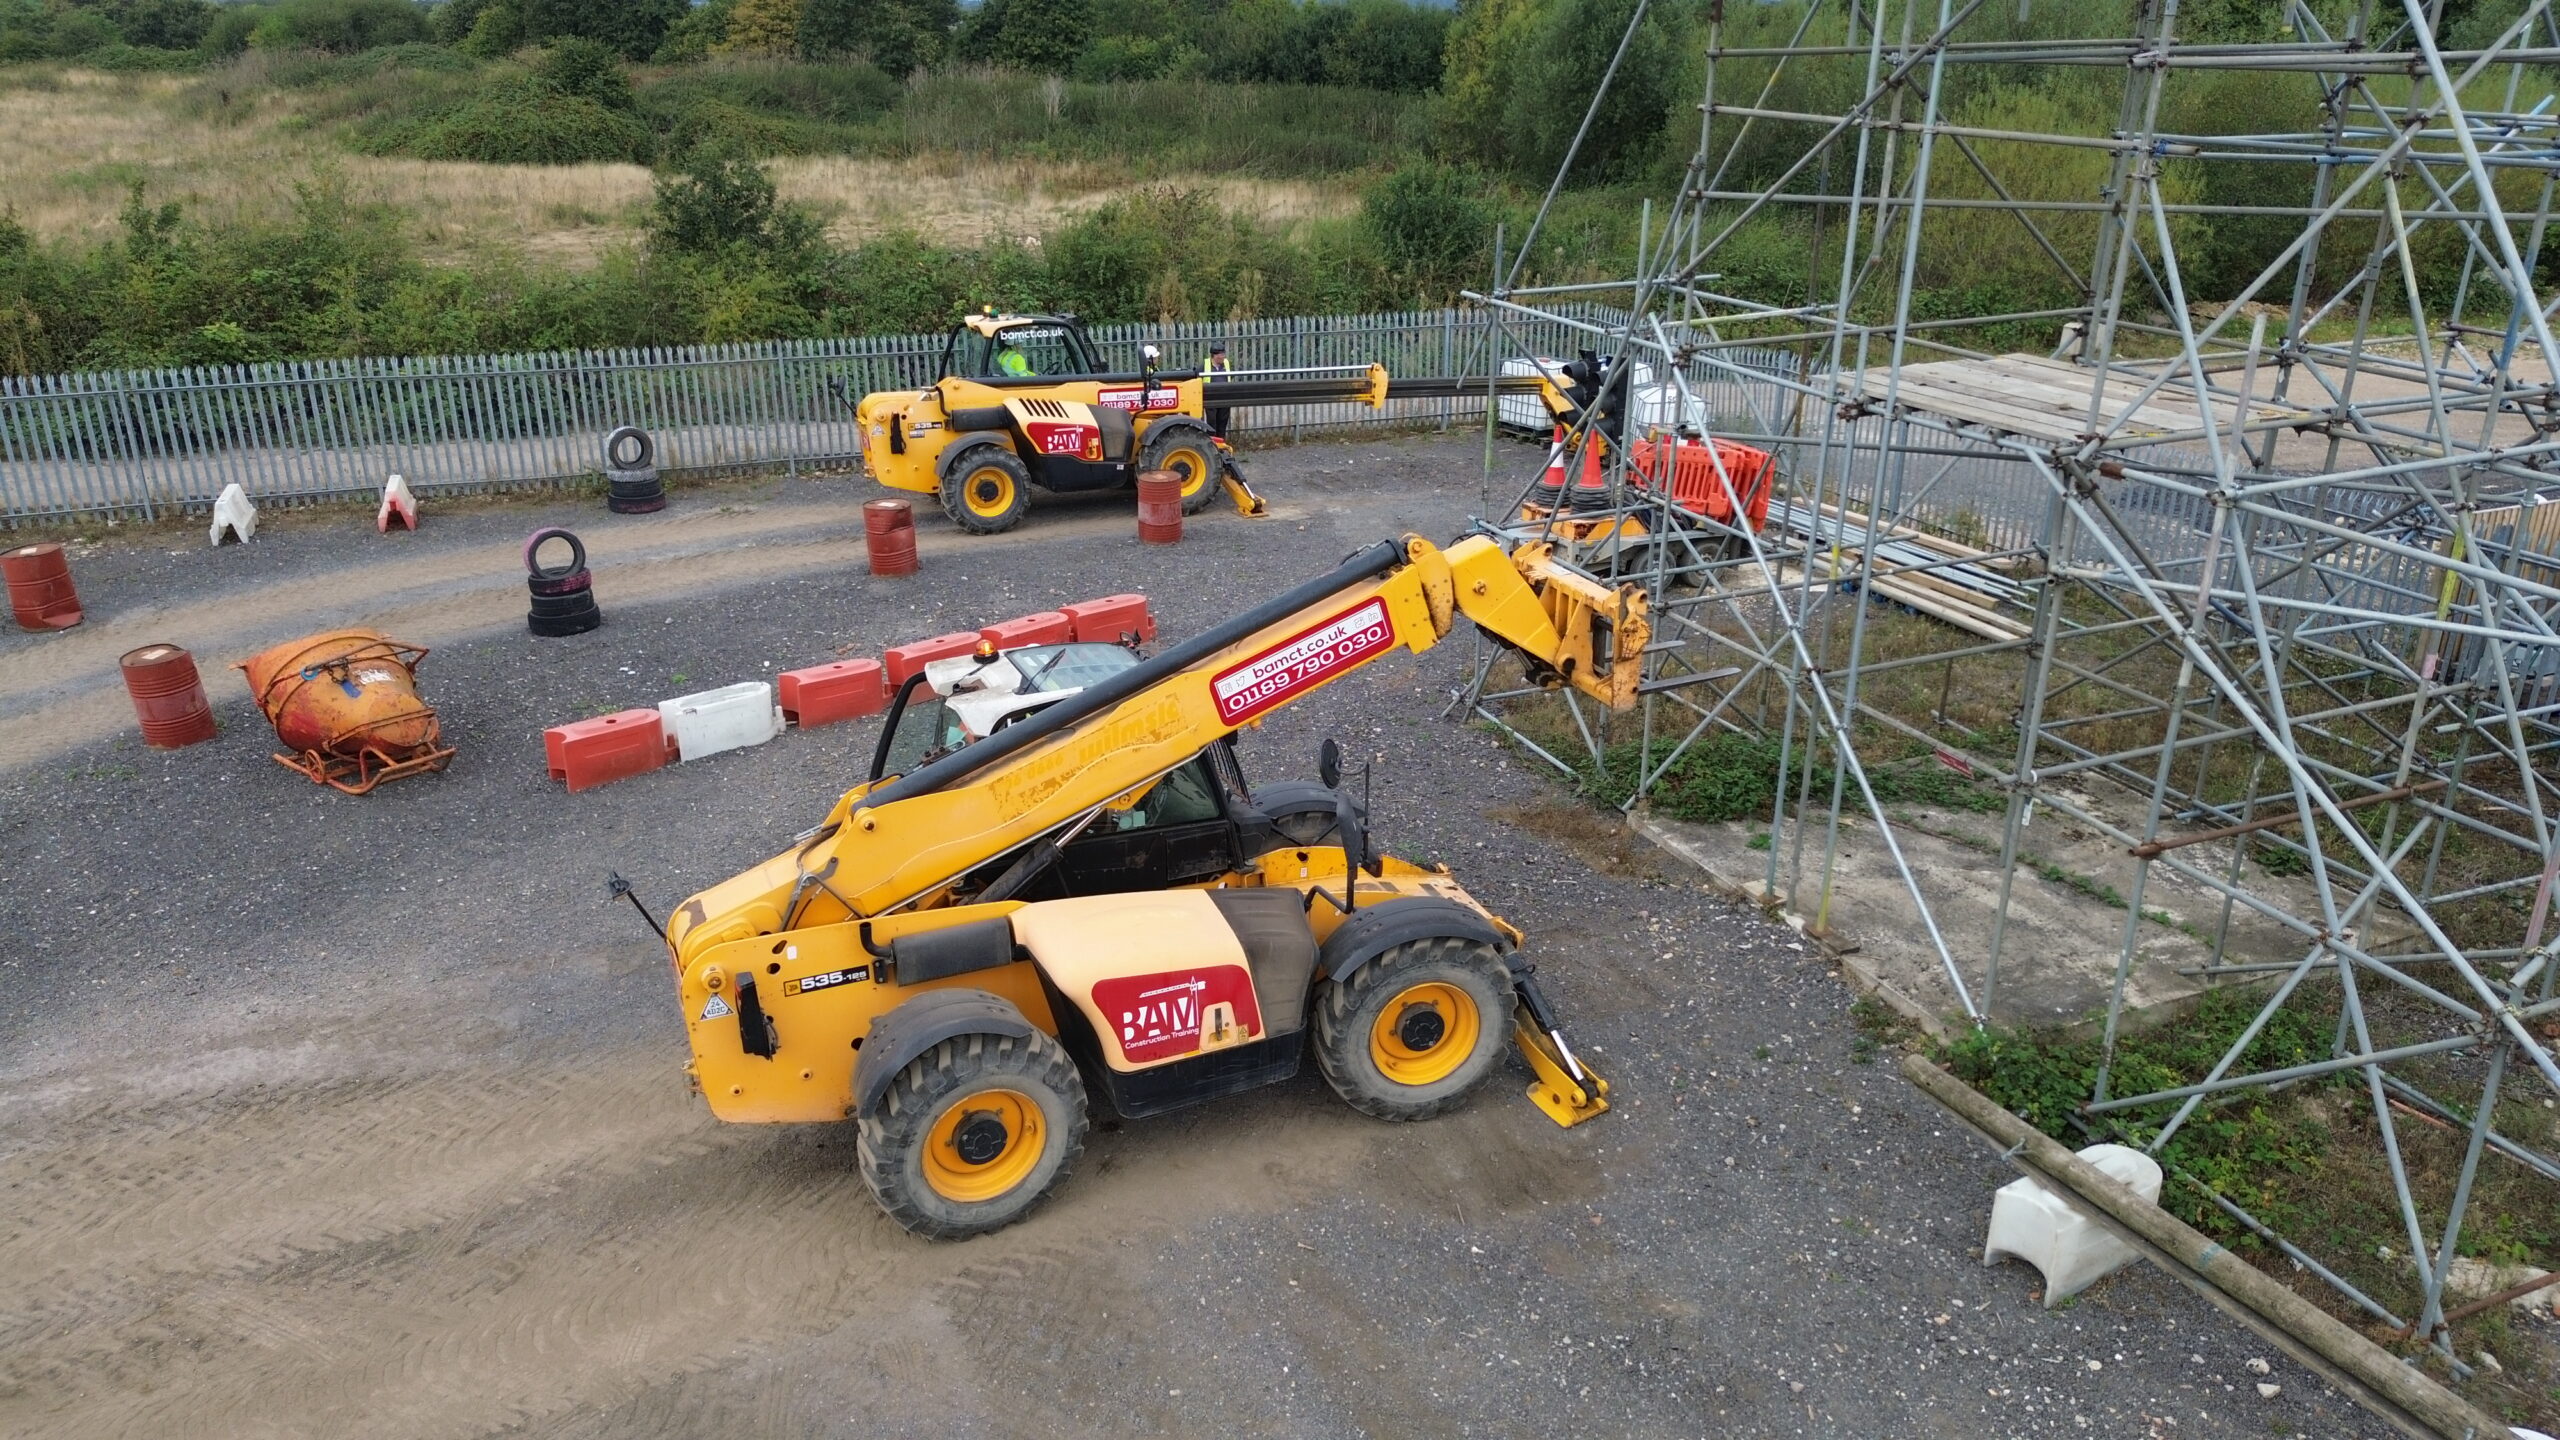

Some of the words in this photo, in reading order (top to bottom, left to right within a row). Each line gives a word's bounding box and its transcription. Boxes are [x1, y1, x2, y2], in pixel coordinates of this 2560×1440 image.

[1000, 327, 1064, 340] bamct.co.uk
[1153, 399, 1174, 408] 030
[1047, 433, 1081, 450] BAM
[1252, 626, 1348, 679] bamct.co.uk
[1229, 672, 1290, 710] 01189
[1292, 649, 1335, 680] 790
[1338, 626, 1382, 656] 030
[801, 971, 867, 989] 535-125
[1123, 996, 1199, 1041] BAM
[1125, 1034, 1171, 1049] Construction
[1171, 1027, 1200, 1039] Training
